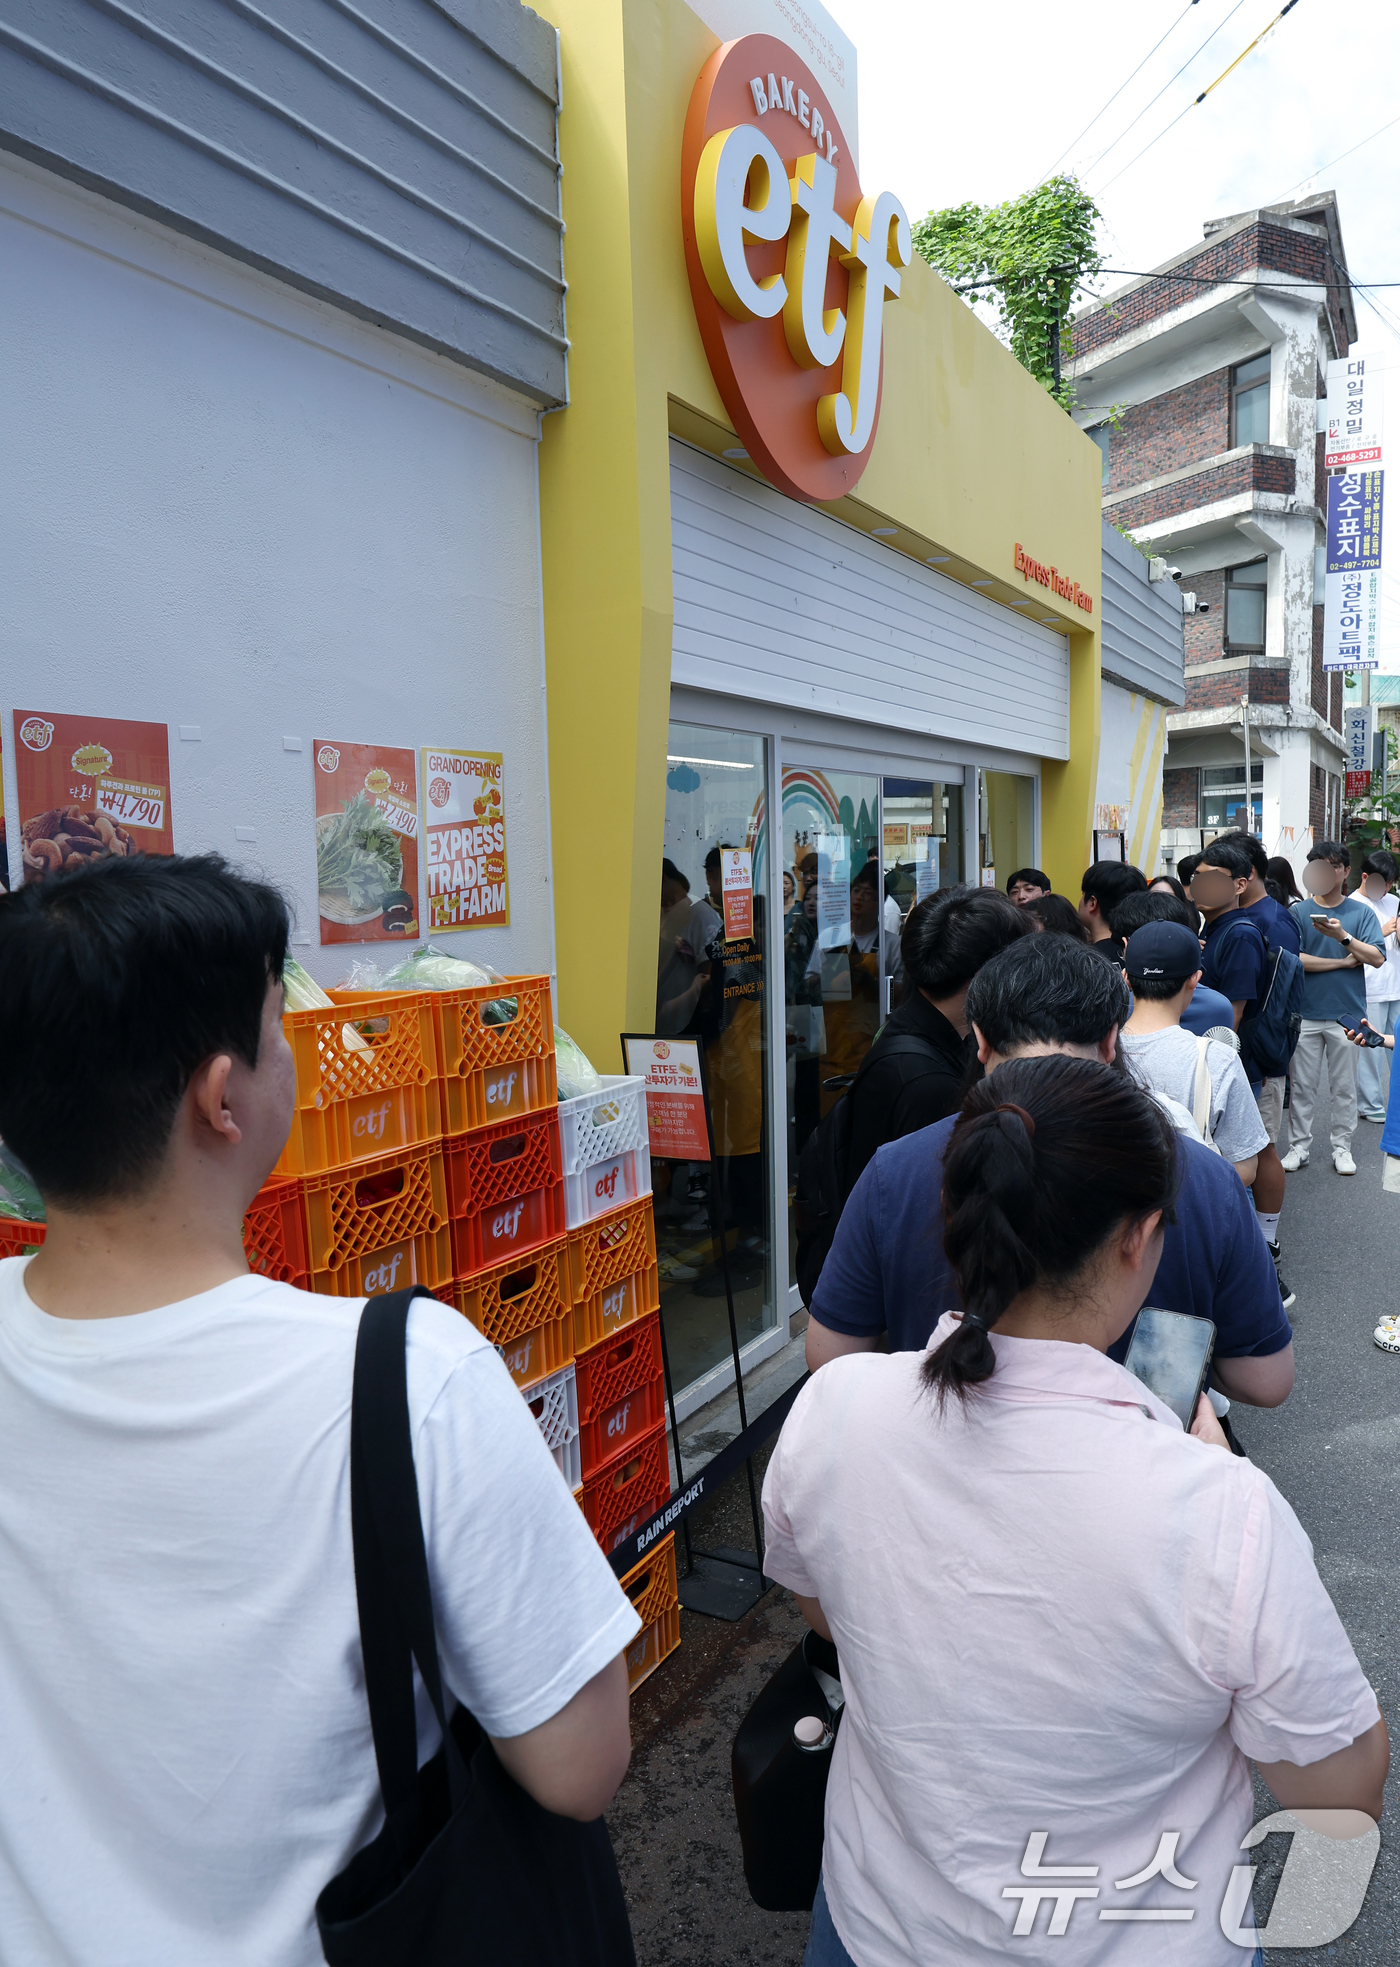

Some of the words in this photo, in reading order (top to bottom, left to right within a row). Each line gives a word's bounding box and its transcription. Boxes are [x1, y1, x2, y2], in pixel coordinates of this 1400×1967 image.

[750, 73, 838, 164] BAKERY
[694, 124, 912, 456] etf
[1346, 360, 1365, 435] 대일정밀
[1329, 419, 1340, 428] B1
[1327, 449, 1378, 465] 02-468-5291
[1014, 542, 1050, 588] Express
[1050, 566, 1073, 602] Trade
[1073, 582, 1092, 614] Farm
[1330, 559, 1380, 571] 02-497-7704
[21, 724, 53, 747] etf
[1351, 719, 1367, 770] 화신철강
[75, 754, 108, 766] Signature
[318, 752, 340, 770] etf
[429, 755, 462, 776] GRAND
[462, 759, 501, 779] OPENING
[100, 790, 161, 825] ₩4,790
[428, 781, 451, 806] etf
[1207, 815, 1220, 825] 3F
[427, 822, 505, 865] EXPRESS
[427, 855, 487, 896] TRADE
[460, 882, 506, 921] FARM
[722, 945, 737, 956] Open
[737, 942, 750, 953] Daily
[722, 959, 734, 968] 11:00
[723, 982, 756, 999] ENTRANCE
[651, 1064, 678, 1075] ETF도
[678, 1076, 698, 1087] 기본!
[485, 1072, 518, 1107] etf
[352, 1100, 392, 1140] etf
[595, 1166, 619, 1199] etf
[492, 1202, 525, 1239] etf
[364, 1252, 404, 1293] etf
[602, 1284, 627, 1319] etf
[504, 1337, 534, 1375] etf
[607, 1402, 631, 1439] etf
[636, 1513, 664, 1553] RAIN
[664, 1476, 706, 1527] REPORT
